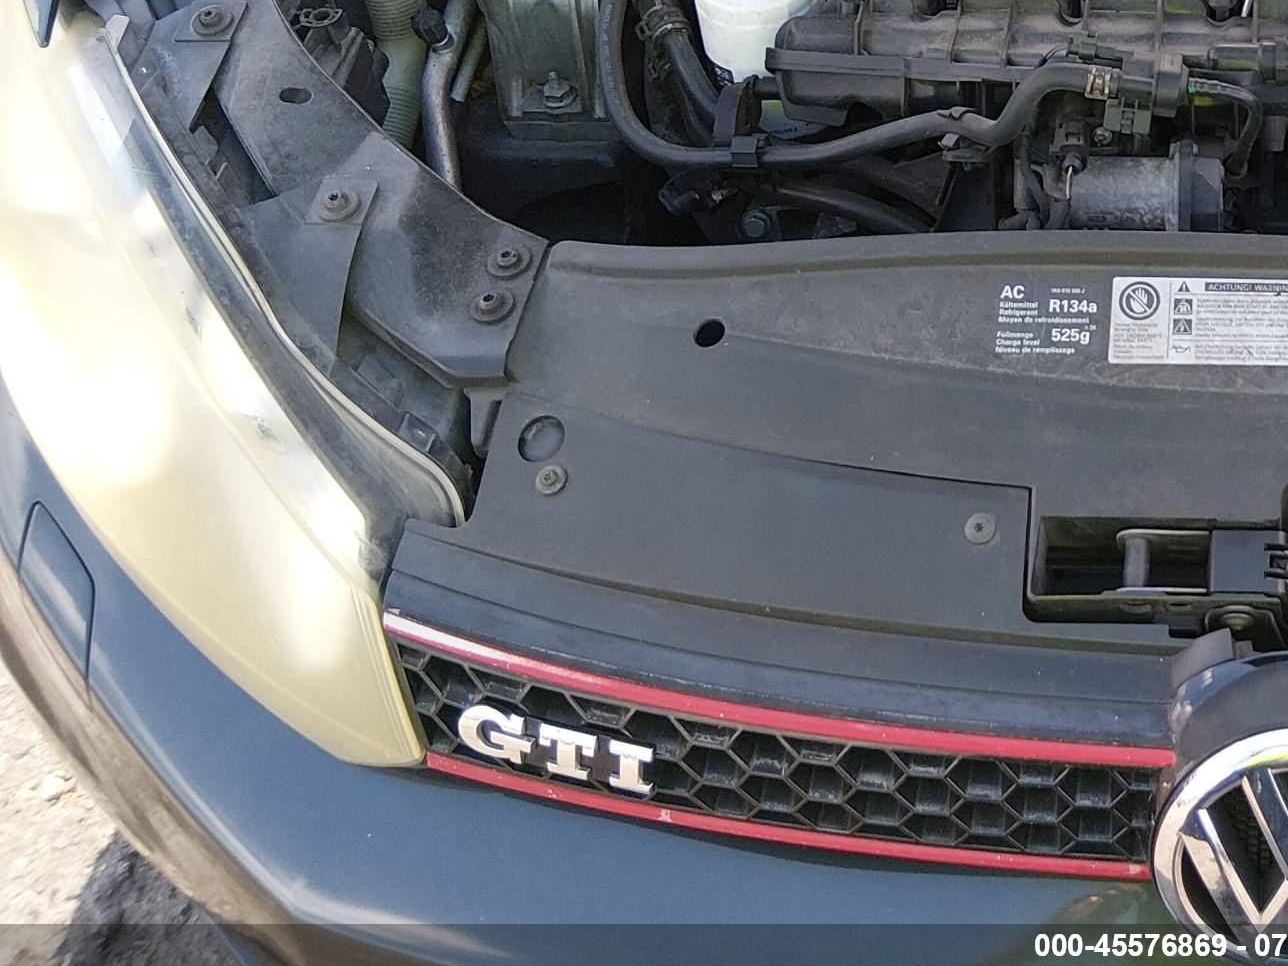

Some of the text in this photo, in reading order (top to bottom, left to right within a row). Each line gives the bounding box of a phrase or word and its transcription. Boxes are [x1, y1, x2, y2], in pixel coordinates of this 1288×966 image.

[1000, 284, 1025, 299] AC
[1208, 283, 1252, 291] ACHTUNG!
[1048, 299, 1097, 313] R134a
[1051, 328, 1090, 344] 525g
[1033, 346, 1075, 354] remplissage
[458, 704, 655, 794] GTI
